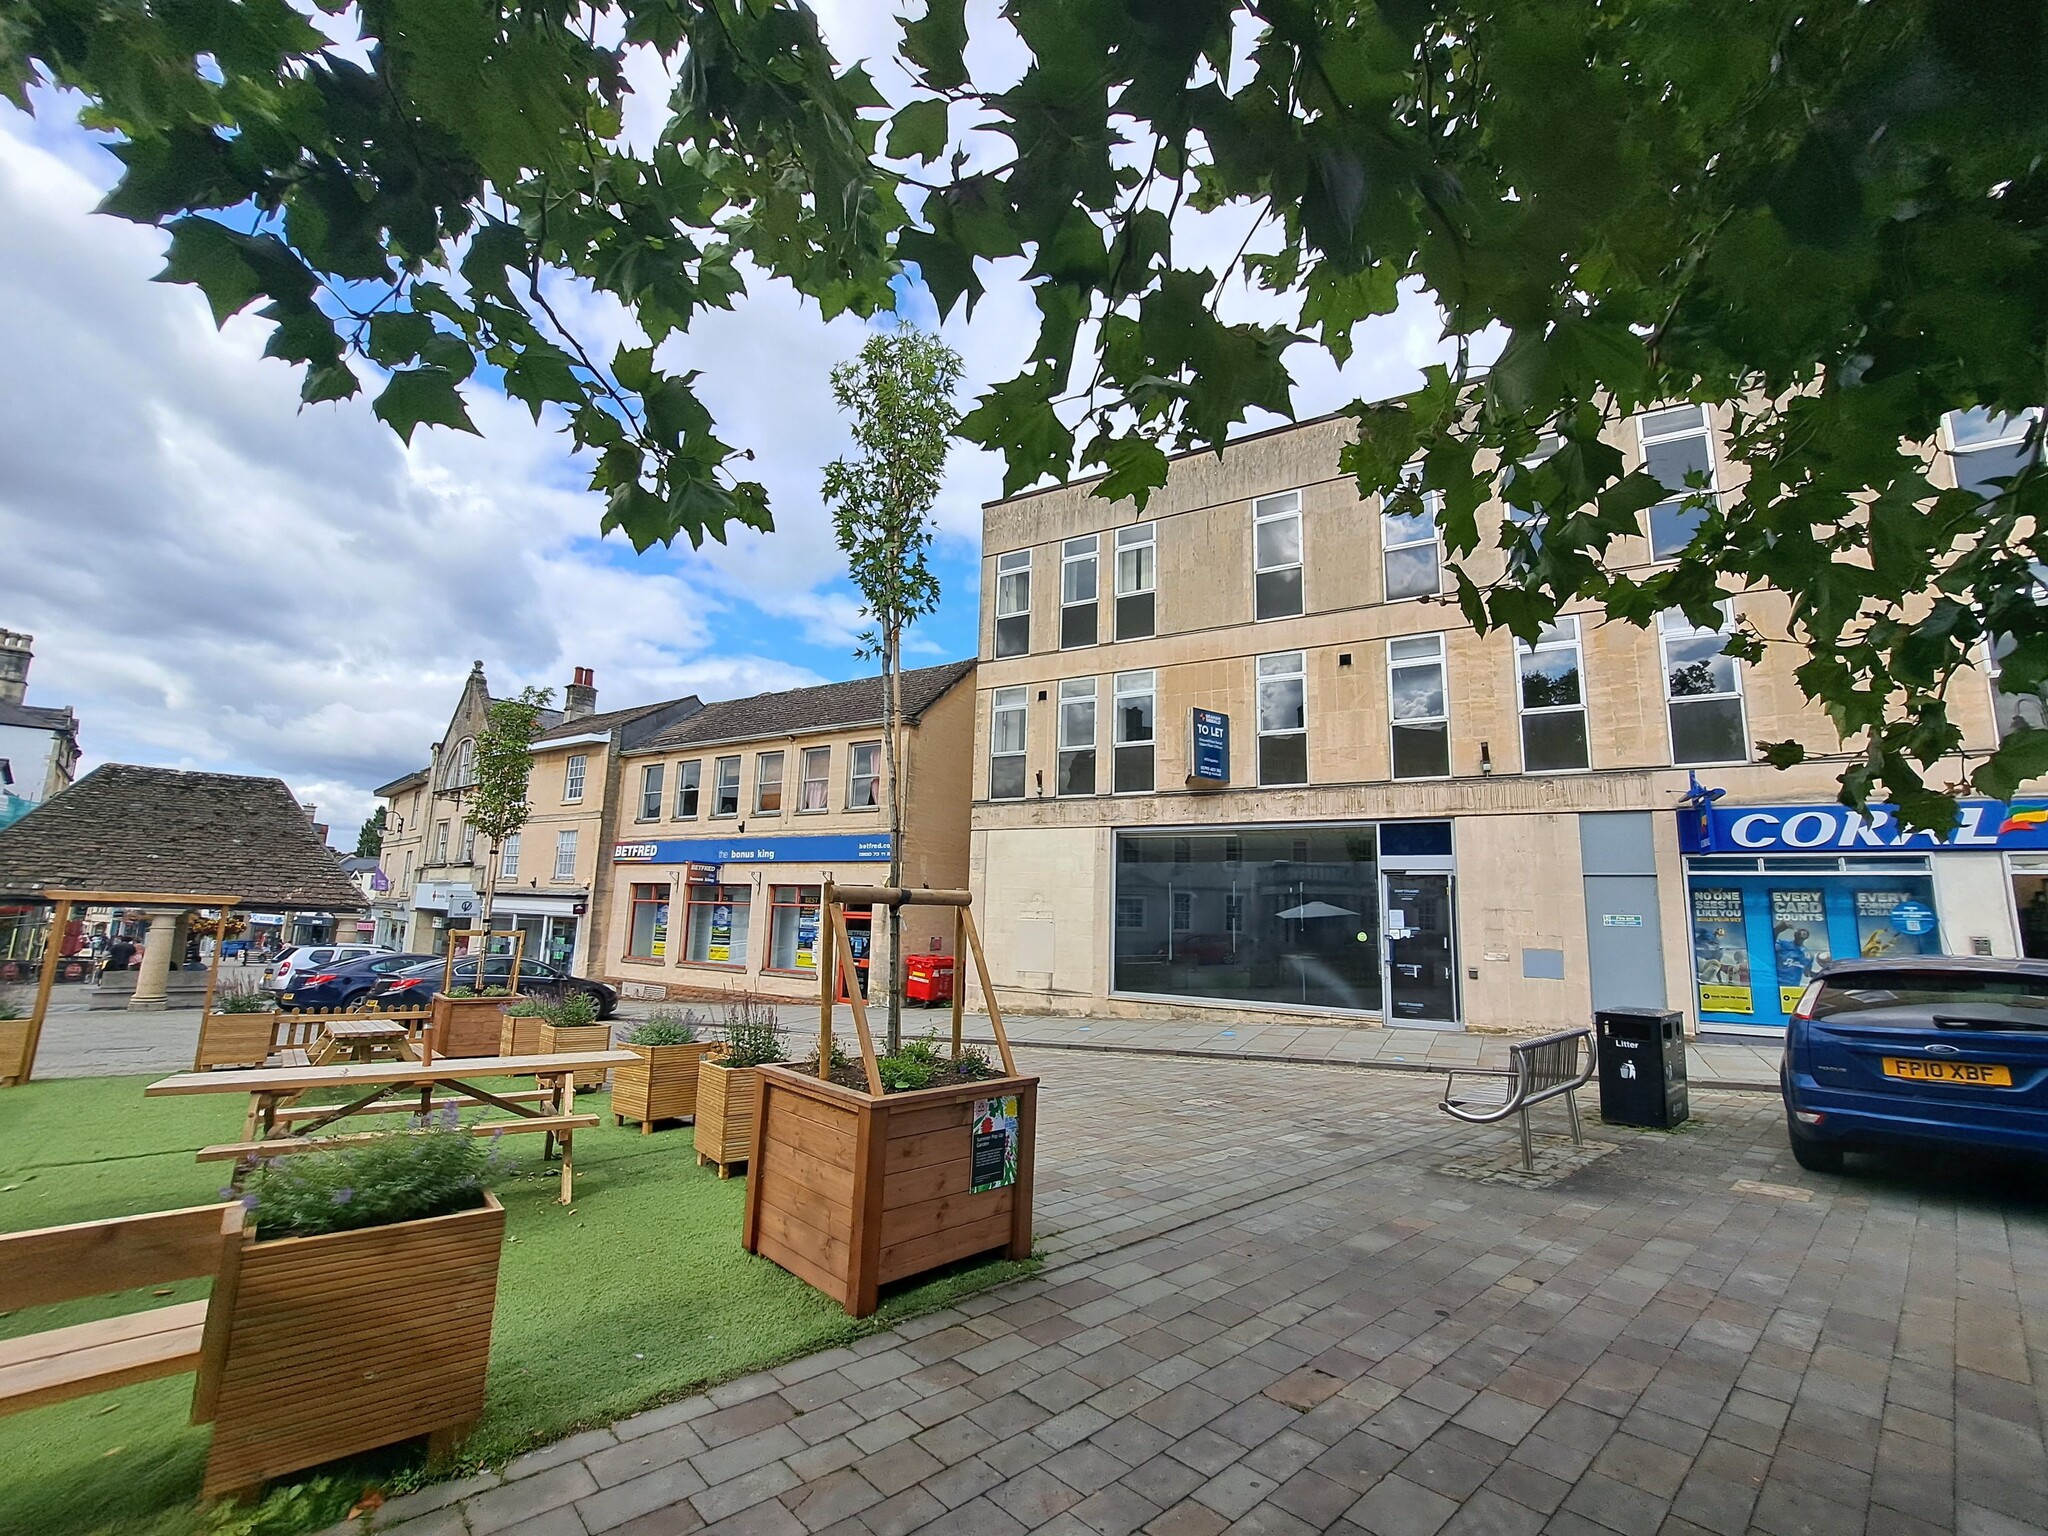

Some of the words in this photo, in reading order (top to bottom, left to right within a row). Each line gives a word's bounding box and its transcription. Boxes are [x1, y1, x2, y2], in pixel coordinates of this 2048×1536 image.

[1197, 724, 1209, 735] TO
[1210, 727, 1223, 738] LET
[614, 845, 657, 857] BETFRED
[718, 851, 729, 859] the
[731, 850, 755, 859] bonus
[757, 849, 775, 860] king
[690, 864, 716, 872] BETFRED
[1695, 892, 1712, 900] NO
[1712, 892, 1740, 900] ONE
[1772, 892, 1821, 901] EVERY
[1857, 893, 1910, 902] EVERY
[1695, 901, 1727, 910] SEES
[1728, 901, 1741, 909] IT
[1774, 902, 1822, 913] CARD
[1696, 909, 1718, 917] LIKE
[1719, 909, 1741, 917] YOU
[1775, 913, 1824, 921] COUNTS
[1615, 1040, 1639, 1049] Litter
[1895, 1060, 1944, 1078] FP10
[1950, 1064, 1995, 1082] XBF
